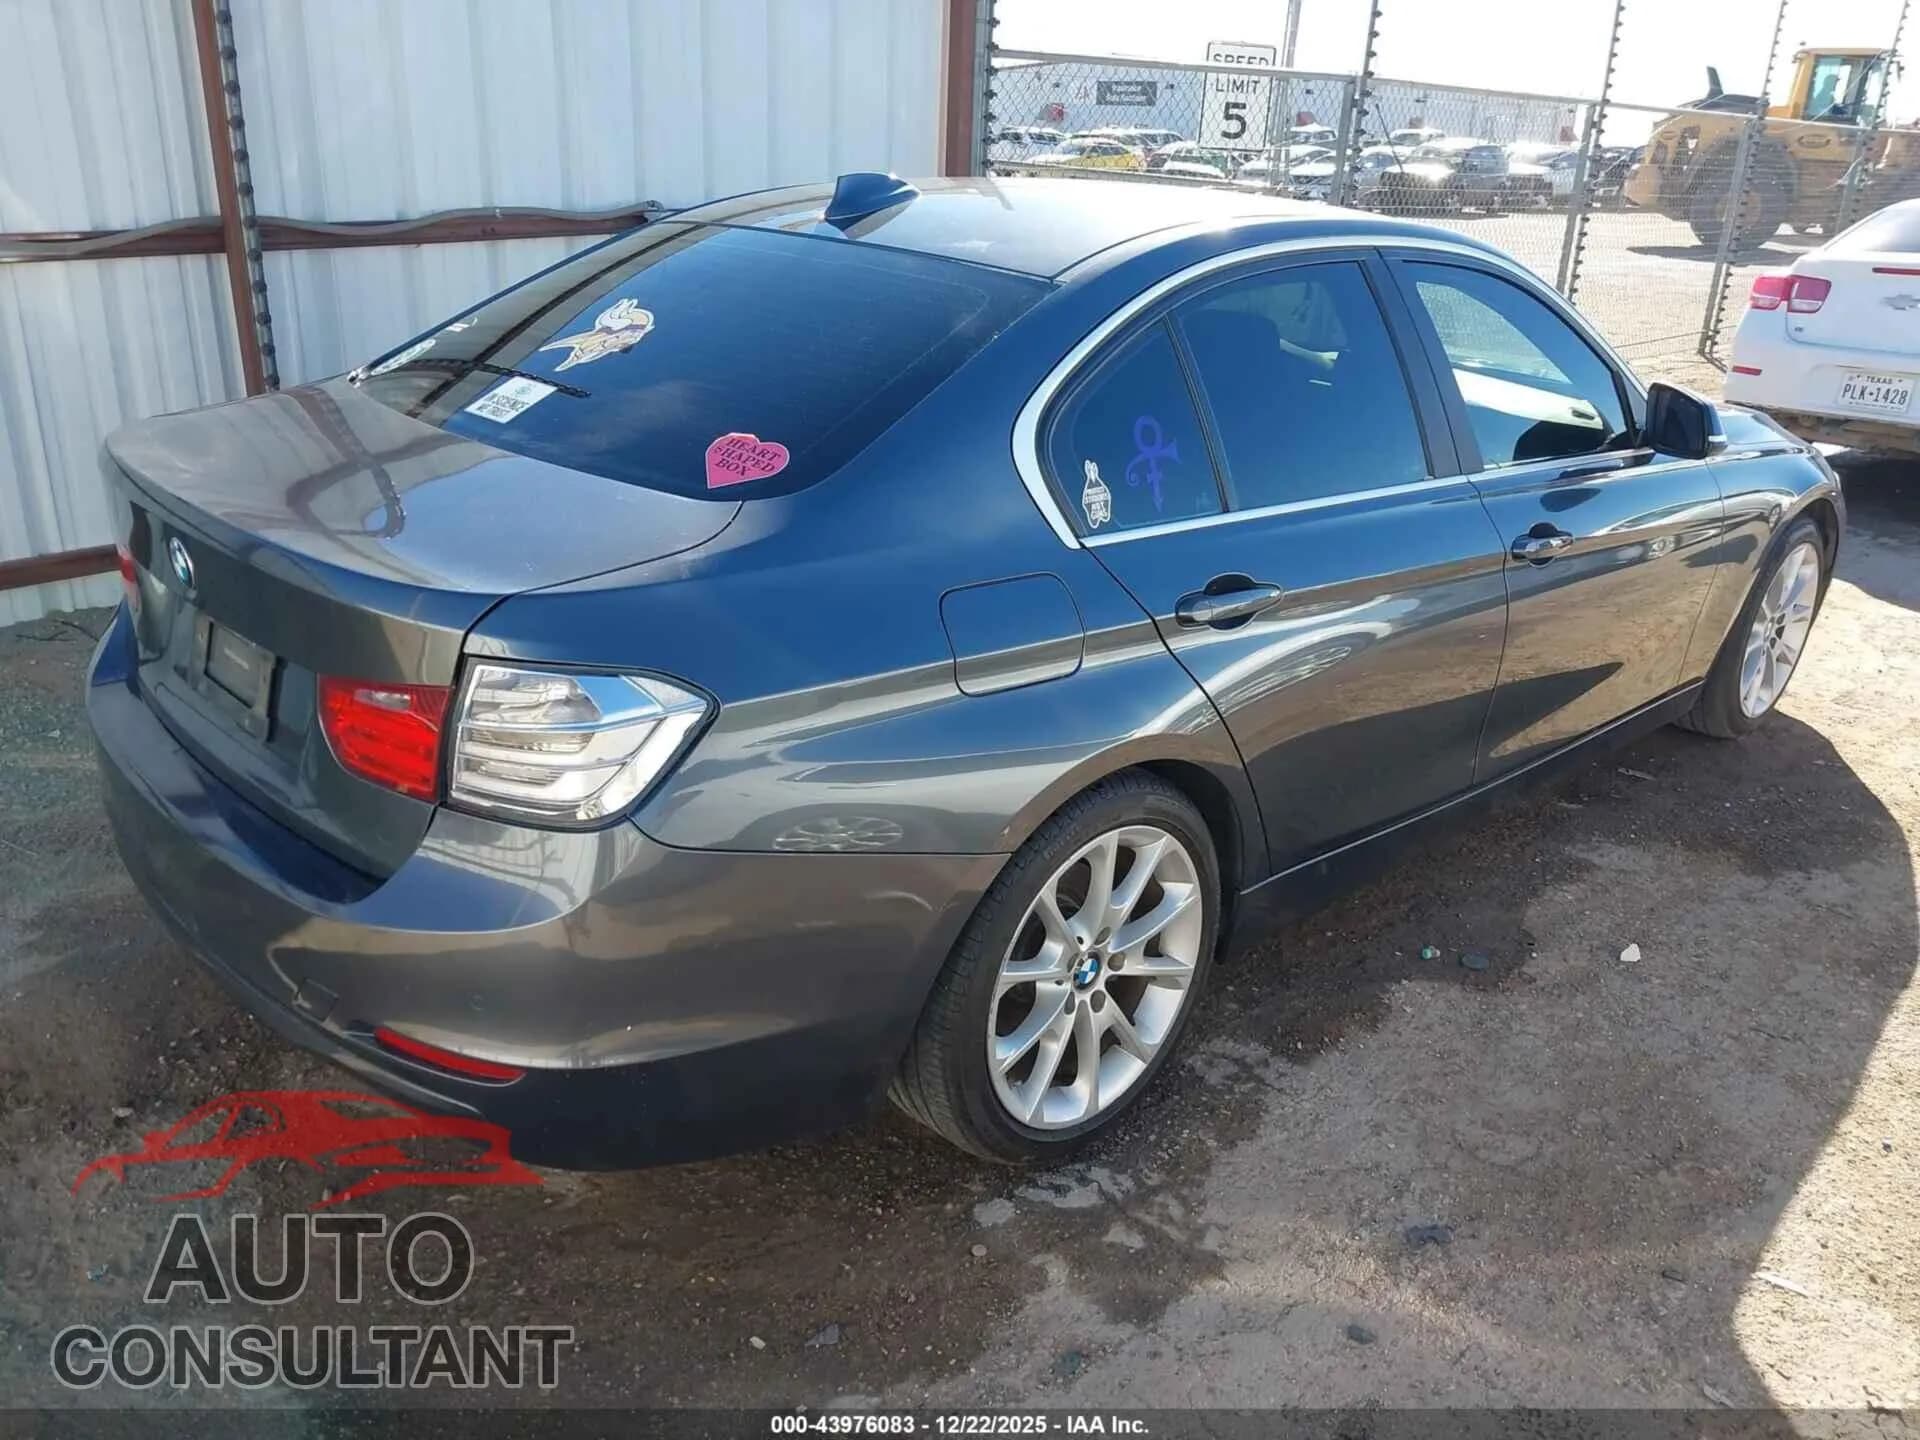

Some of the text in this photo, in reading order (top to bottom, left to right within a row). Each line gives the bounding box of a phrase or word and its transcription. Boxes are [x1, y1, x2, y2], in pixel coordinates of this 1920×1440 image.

[1215, 75, 1260, 94] LIMIT
[1221, 101, 1247, 139] 5
[1866, 375, 1893, 385] TEXAS
[714, 446, 775, 472] SHAPED
[726, 438, 781, 461] HEART
[715, 458, 750, 476] BOX
